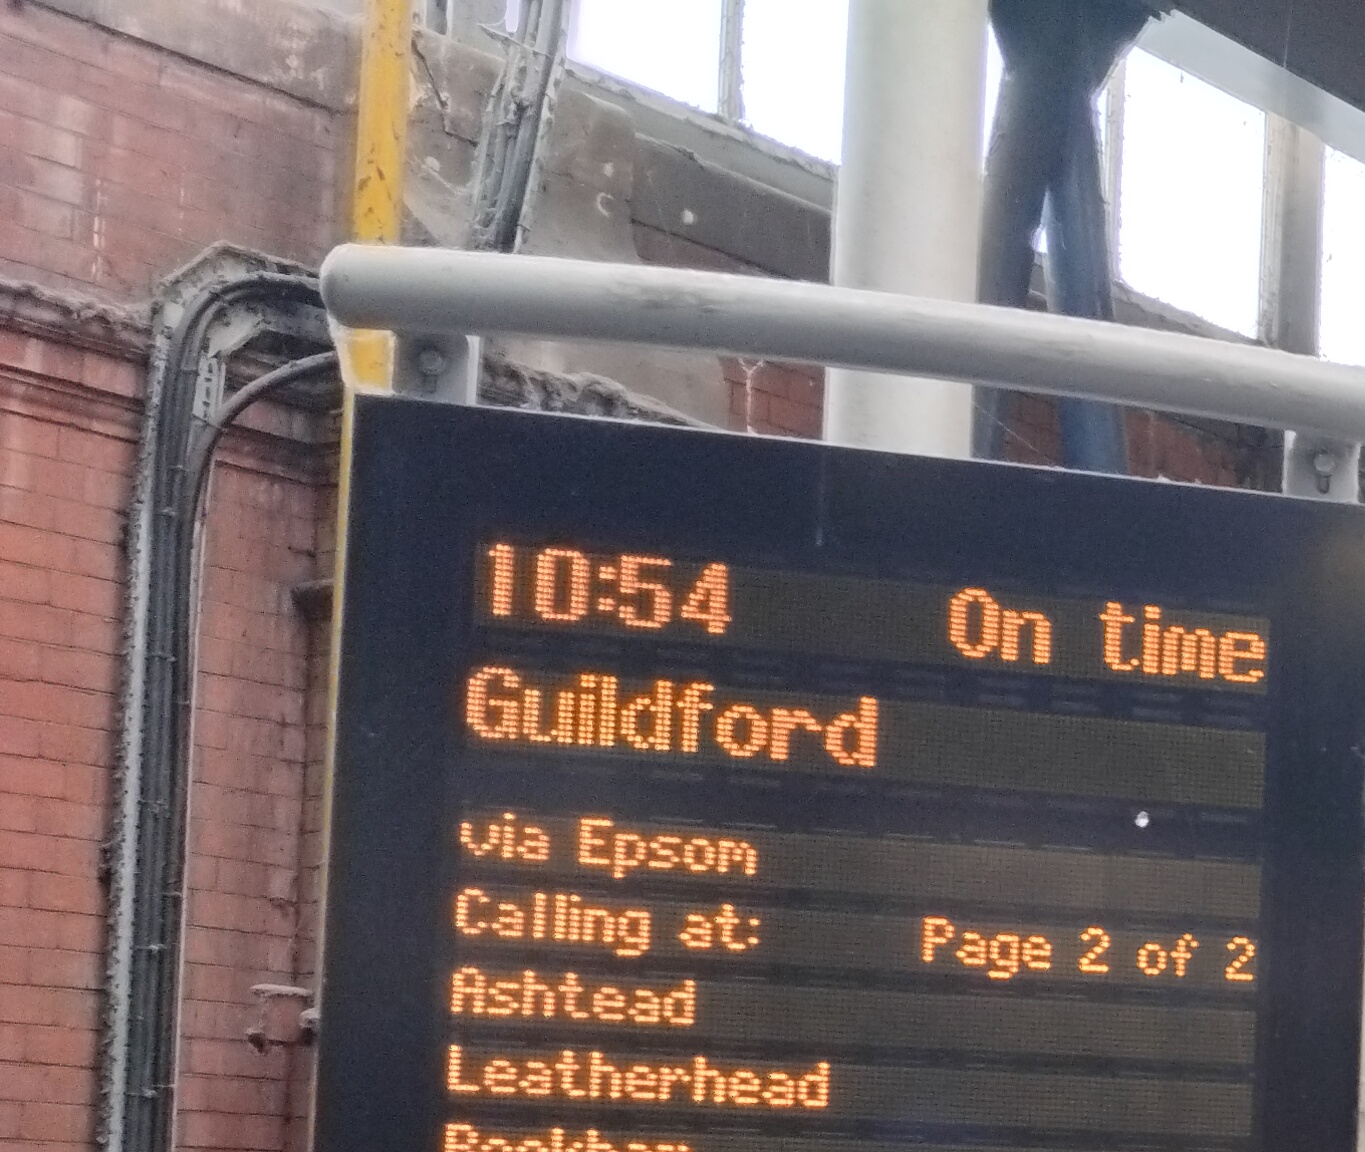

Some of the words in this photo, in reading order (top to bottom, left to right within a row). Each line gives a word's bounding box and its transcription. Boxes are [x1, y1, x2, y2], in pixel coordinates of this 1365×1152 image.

[488, 543, 732, 634] 10:54
[948, 587, 1052, 665] On
[1099, 601, 1266, 684] time
[465, 666, 879, 768] Guildford
[459, 812, 551, 863] via
[576, 817, 758, 880] Epsom
[454, 886, 652, 957] Calling
[677, 903, 761, 952] at:
[921, 916, 1053, 980] Page
[1077, 926, 1112, 974] 2
[1136, 933, 1200, 977] of
[1224, 936, 1256, 982] 2
[450, 964, 697, 1027] Ashtead
[446, 1044, 831, 1110] Leatherhead
